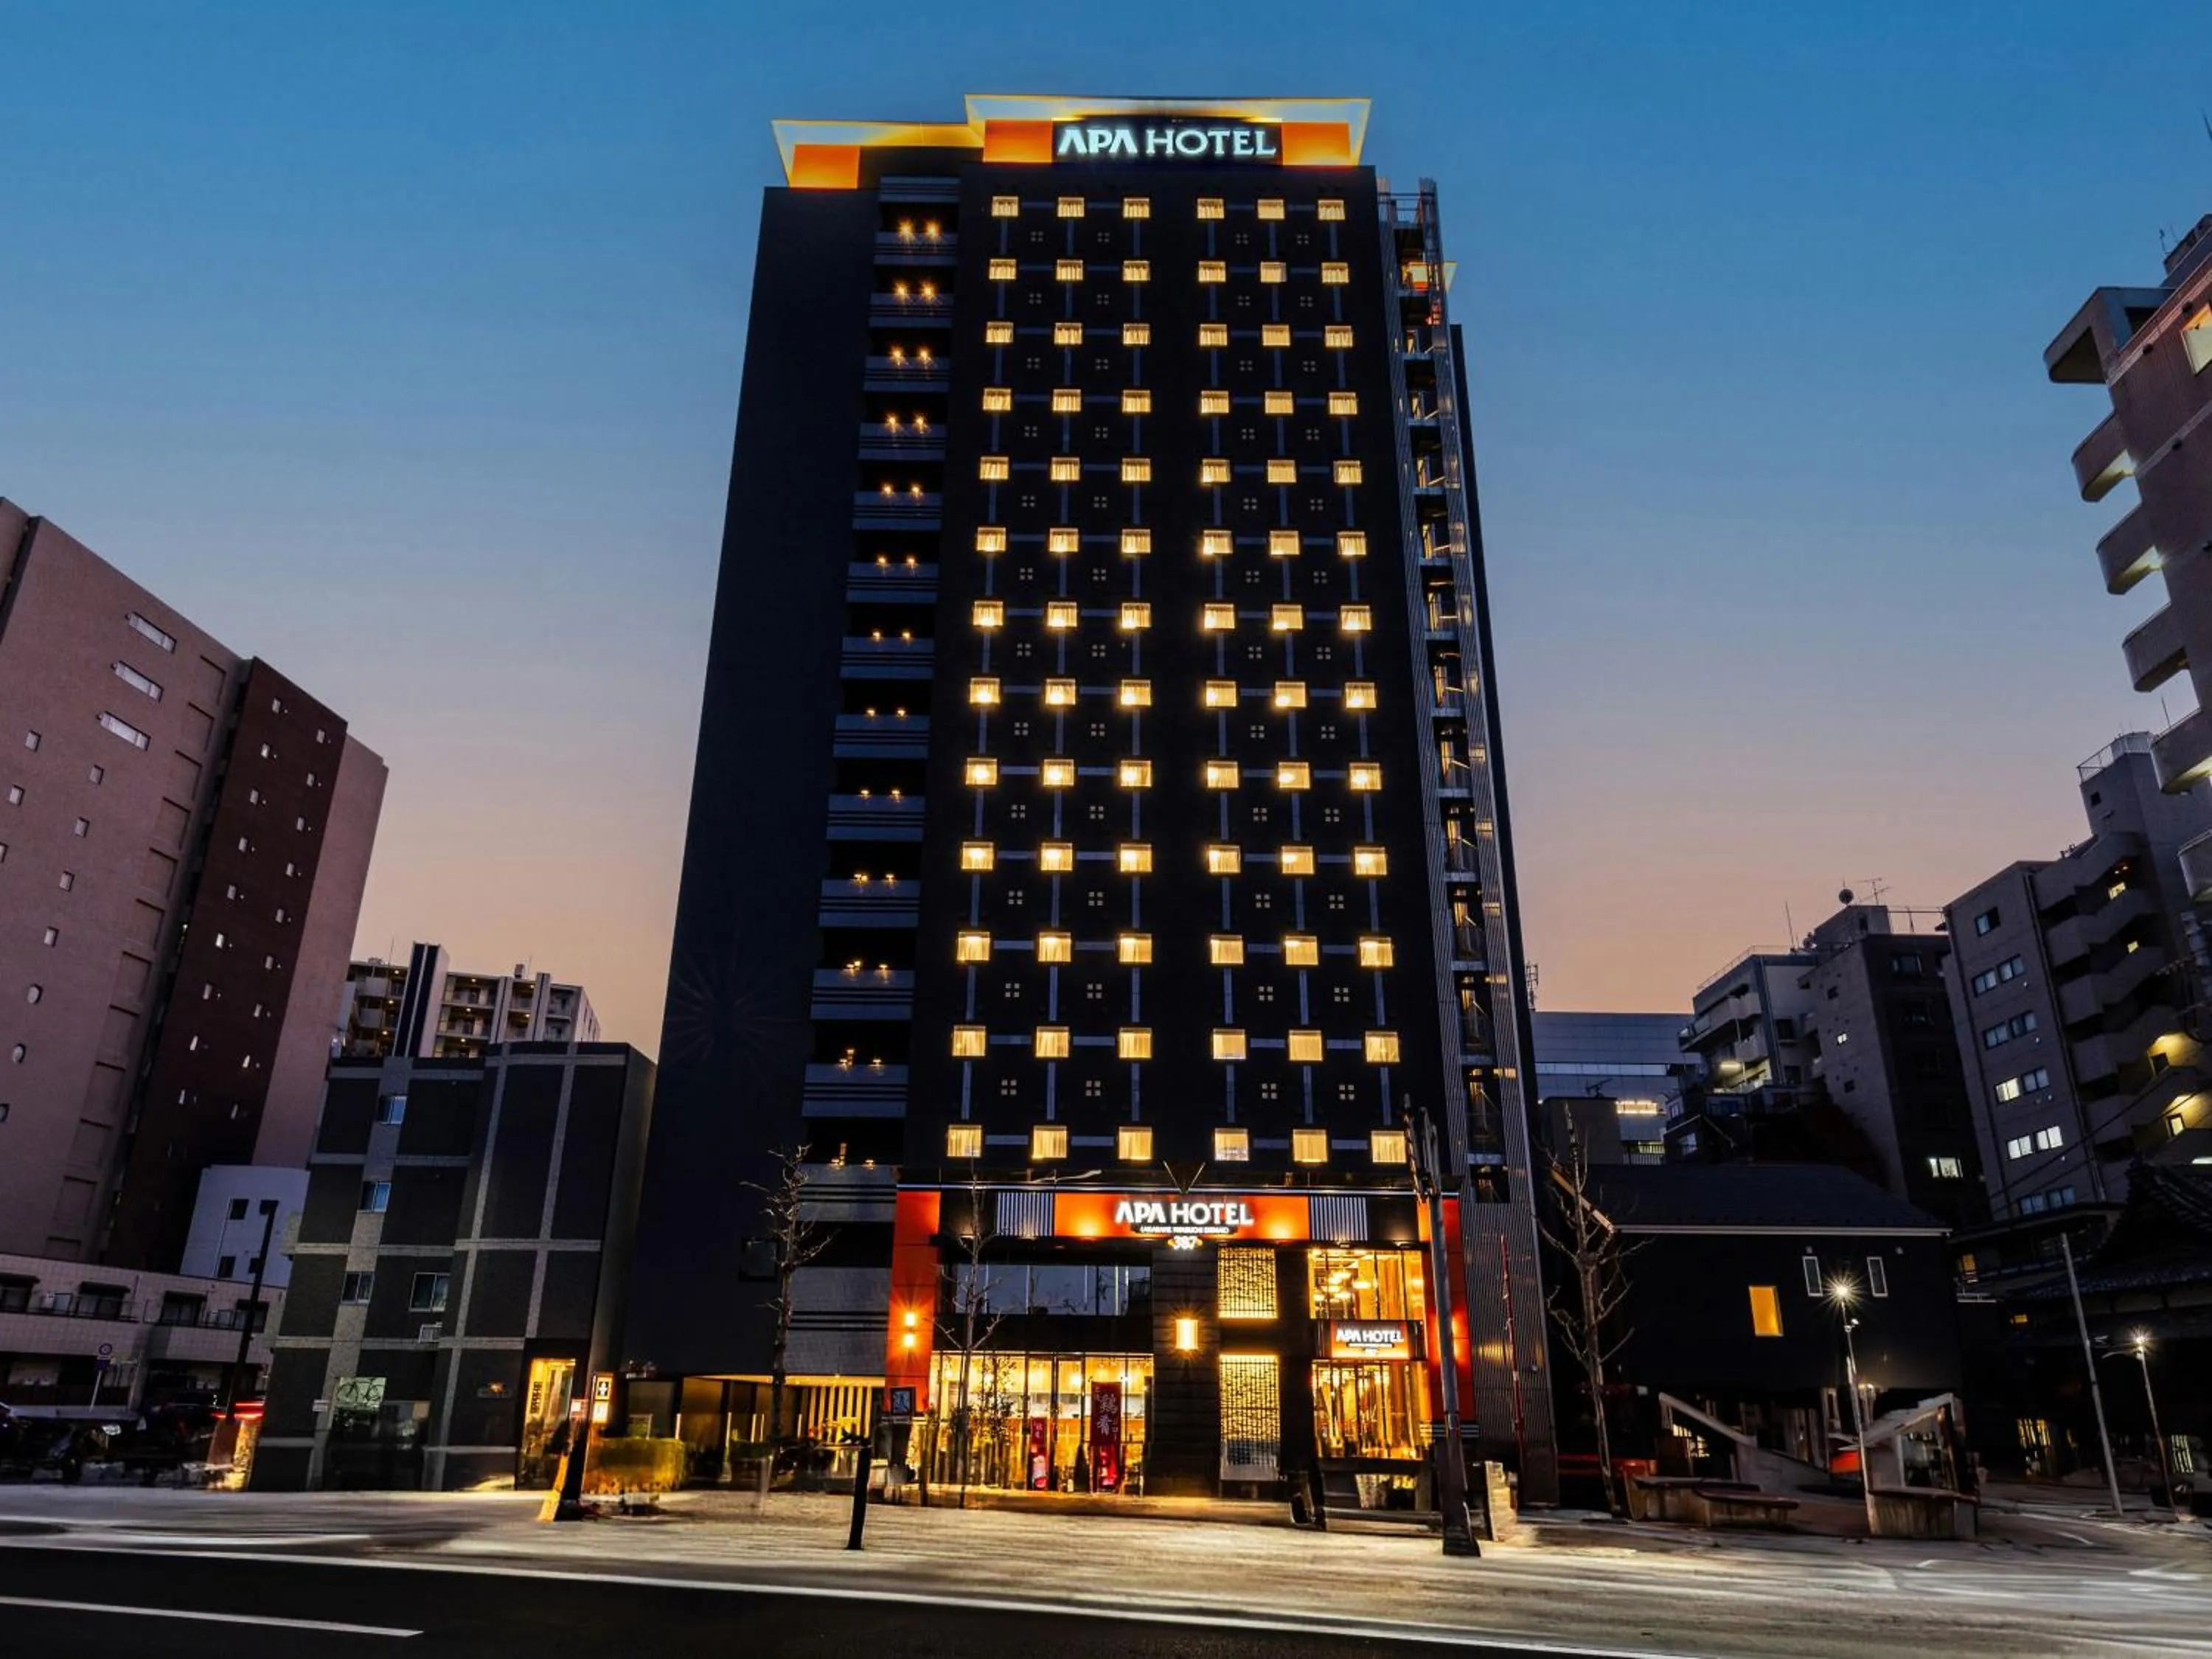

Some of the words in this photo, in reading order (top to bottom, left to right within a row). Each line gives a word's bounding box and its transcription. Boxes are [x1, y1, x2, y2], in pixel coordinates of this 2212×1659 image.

[1057, 129, 1138, 154] APA
[1145, 128, 1277, 156] HOTEL
[1116, 1203, 1166, 1223] APA
[1171, 1203, 1254, 1225] HOTEL
[1335, 1329, 1362, 1342] APA
[1362, 1329, 1405, 1343] HOTEL
